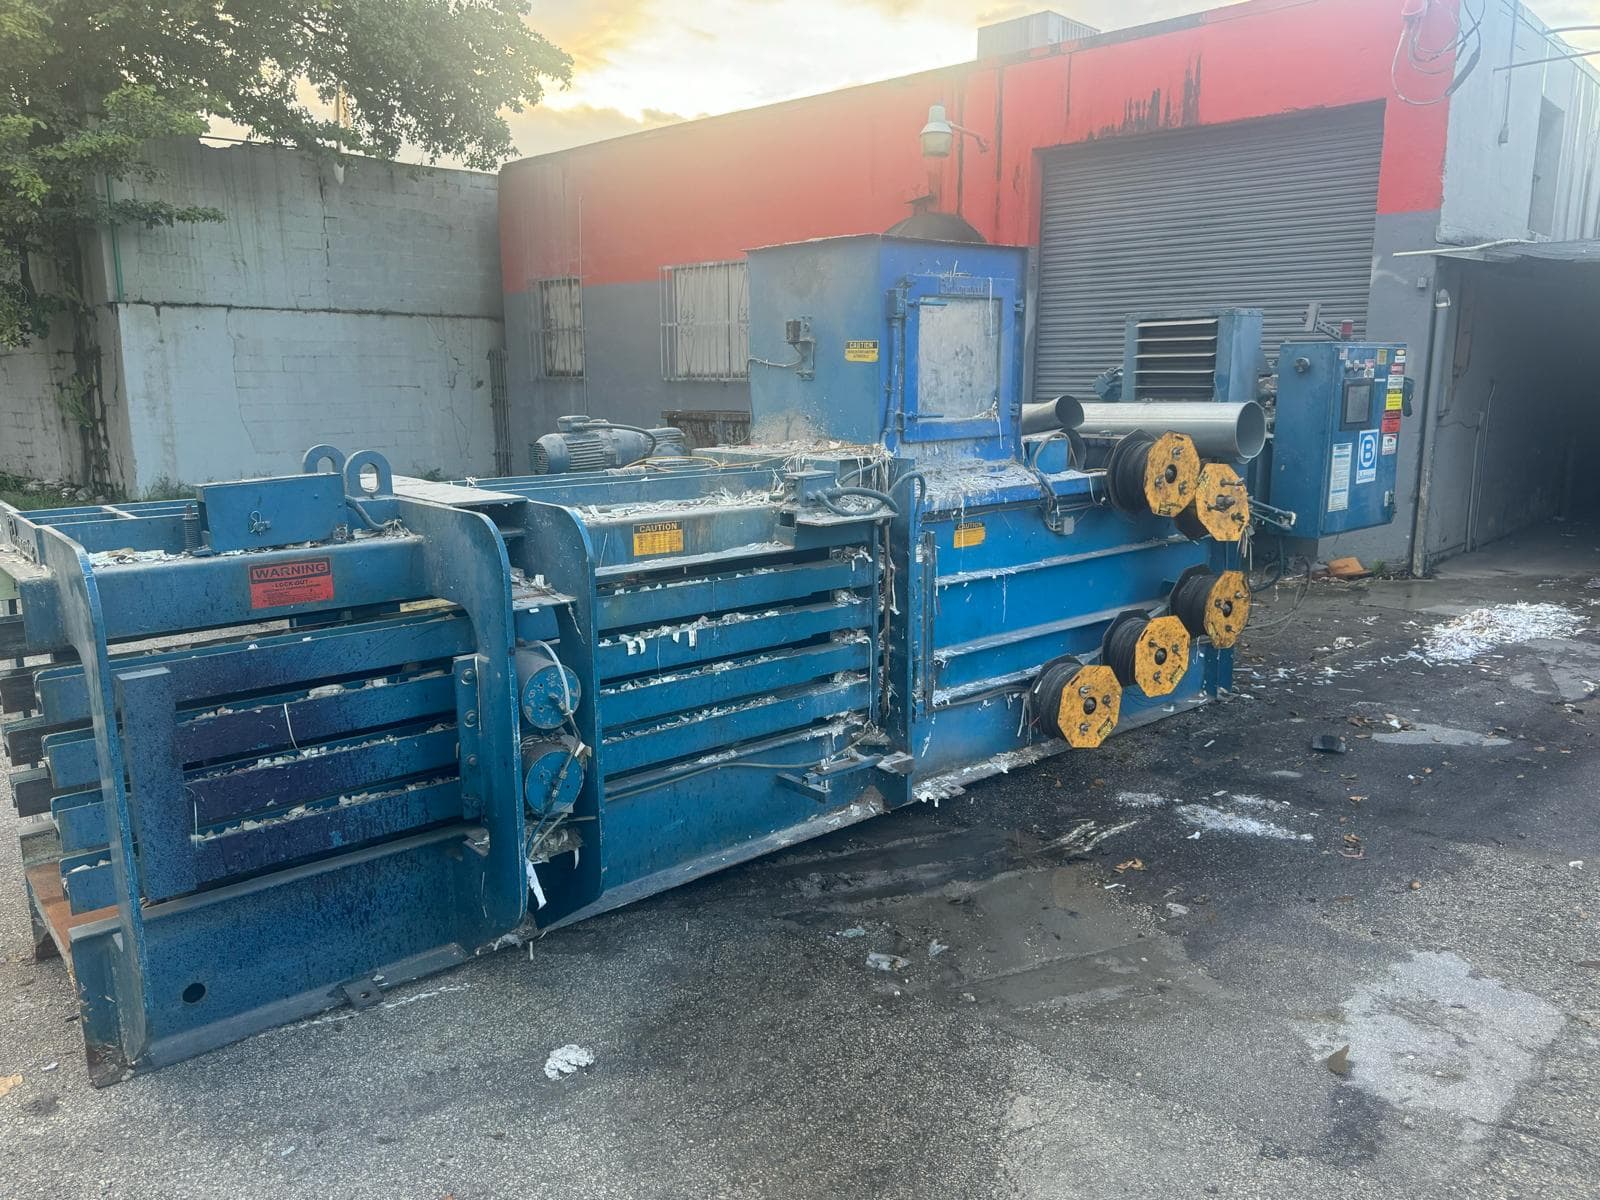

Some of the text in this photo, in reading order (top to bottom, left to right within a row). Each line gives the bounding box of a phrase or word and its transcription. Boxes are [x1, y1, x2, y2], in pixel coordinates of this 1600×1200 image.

[1363, 439, 1373, 463] B
[639, 522, 678, 532] CAUTION
[255, 563, 326, 578] WARNING
